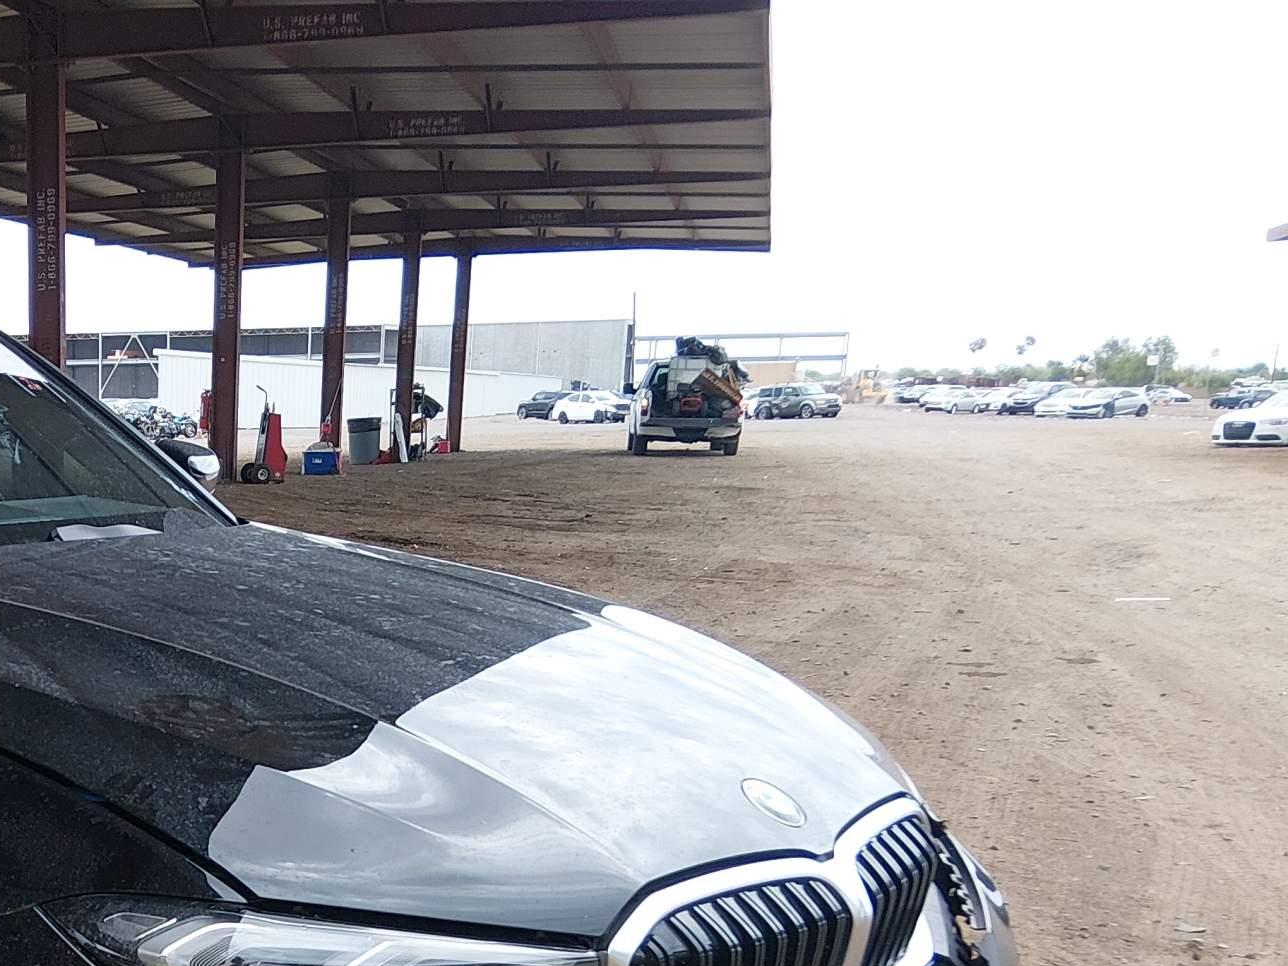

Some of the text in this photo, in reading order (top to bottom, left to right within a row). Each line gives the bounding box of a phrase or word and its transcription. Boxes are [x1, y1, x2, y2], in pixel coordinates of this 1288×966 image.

[290, 13, 337, 27] PREFAB
[36, 217, 46, 263] PREFAB
[47, 188, 57, 290] 1-866-799-0969
